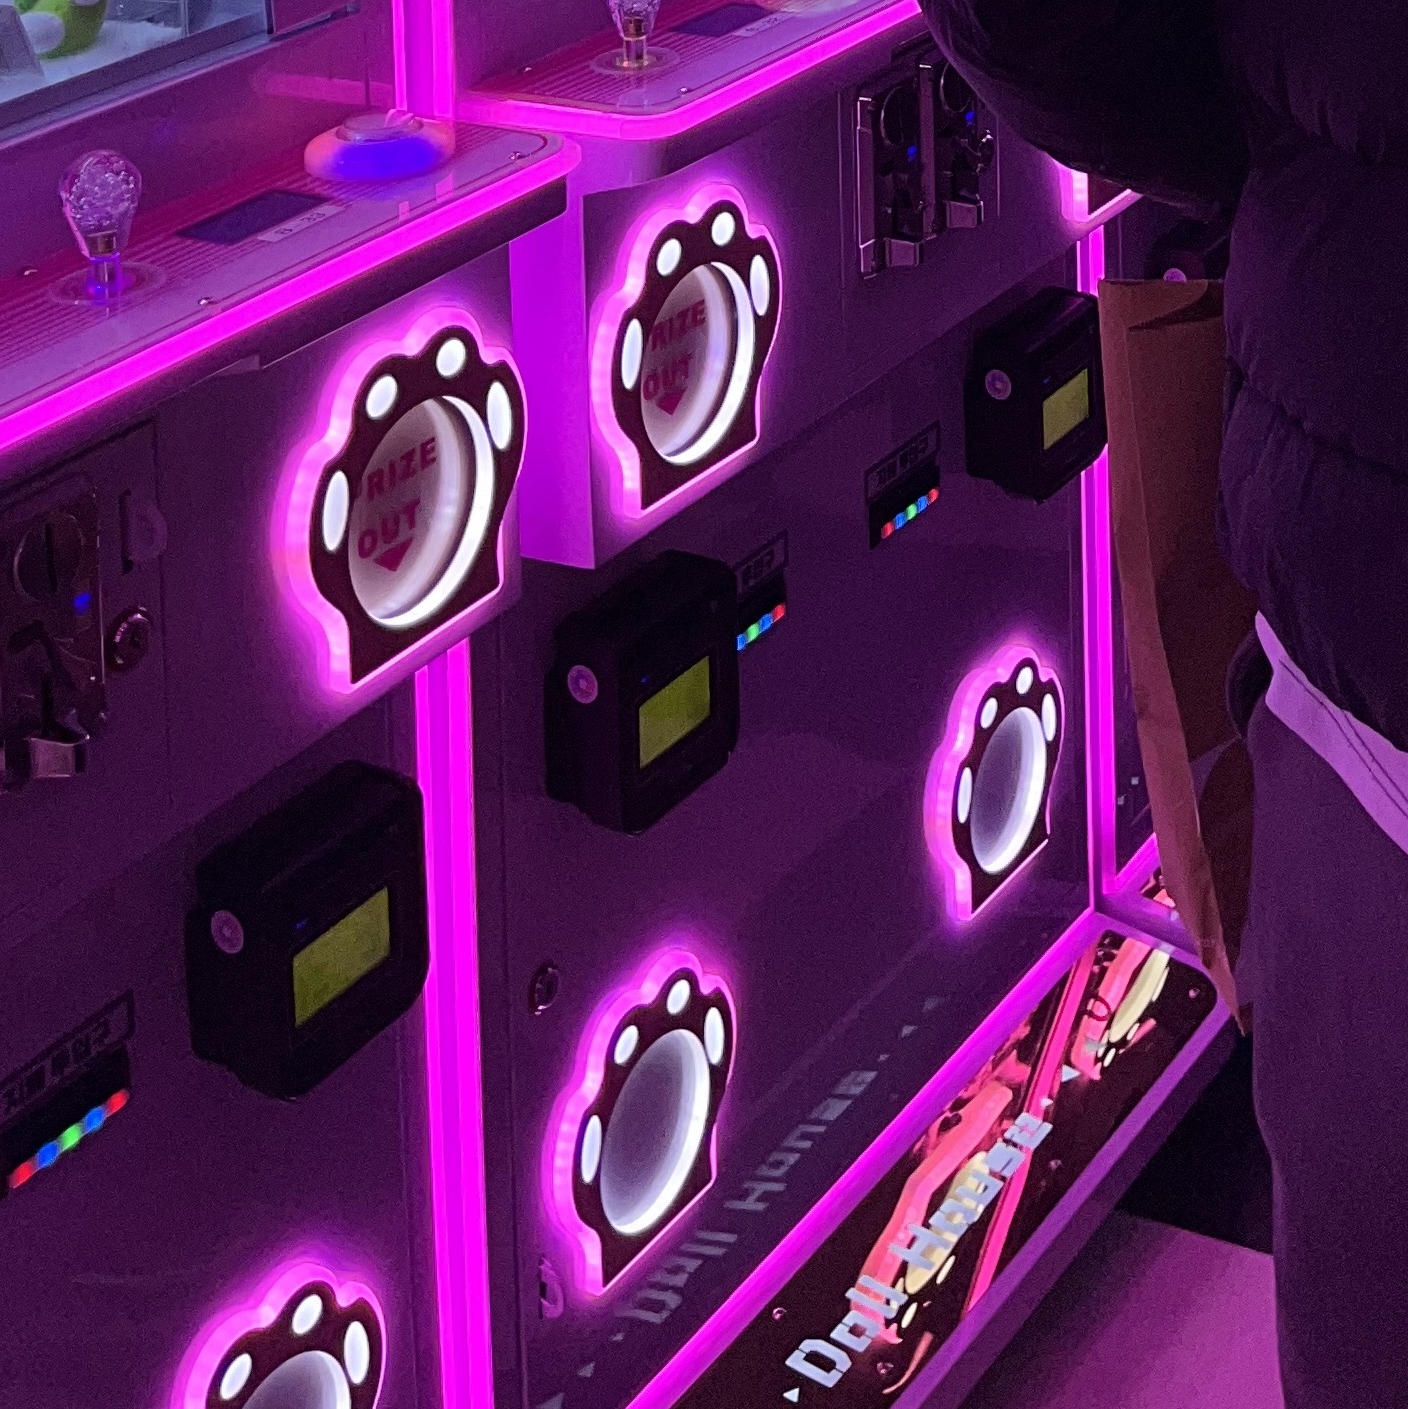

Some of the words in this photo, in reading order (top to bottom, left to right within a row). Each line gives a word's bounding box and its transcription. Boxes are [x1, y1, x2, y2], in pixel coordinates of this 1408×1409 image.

[652, 299, 707, 352] RIZE
[357, 436, 437, 500] RIZE
[357, 498, 421, 559] OUT
[784, 1274, 909, 1389] Doll
[888, 1111, 1054, 1271] House
